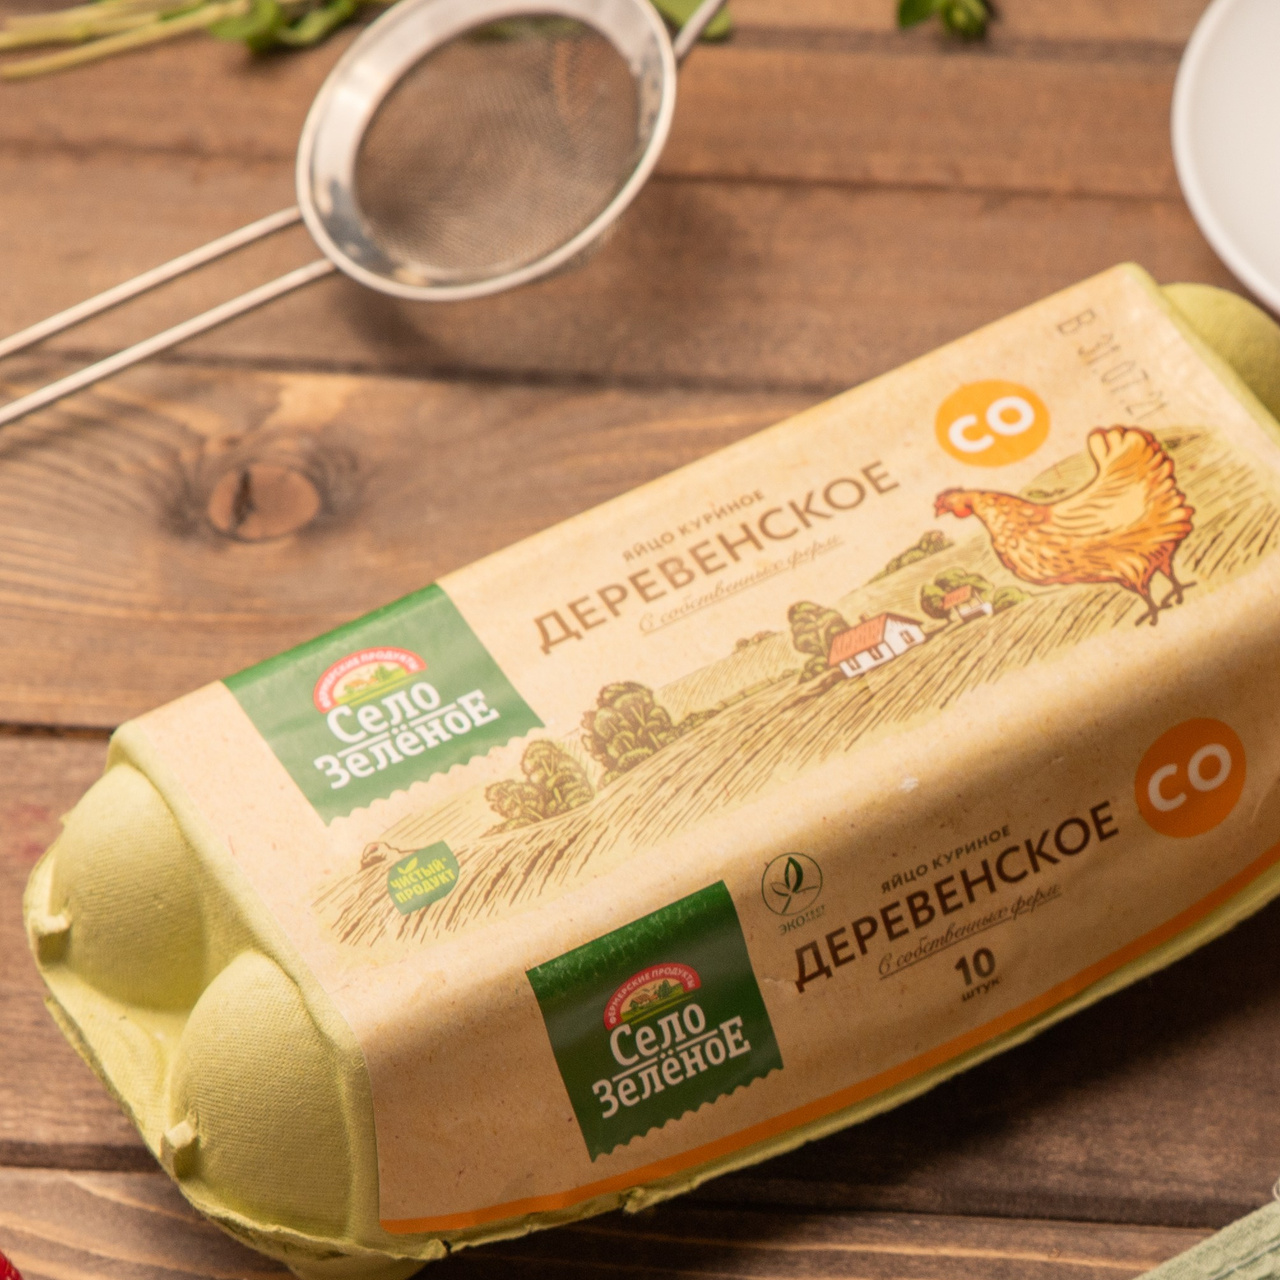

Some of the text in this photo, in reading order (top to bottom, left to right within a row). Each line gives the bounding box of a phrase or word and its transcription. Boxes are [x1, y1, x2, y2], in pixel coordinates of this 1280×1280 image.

[533, 459, 900, 656] ДЕРЕВЕНСКОЕ
[622, 489, 765, 563] ЯЙЦО КУРИНОЕ
[326, 681, 442, 744] Село
[394, 868, 456, 904] ПРОДУКТ
[880, 824, 1011, 895] ЯЙЦО КУРИНОЕ
[793, 800, 1120, 993] ДЕРЕВЕНСКОЕ
[954, 946, 996, 987] 10
[609, 1003, 706, 1067] Село
